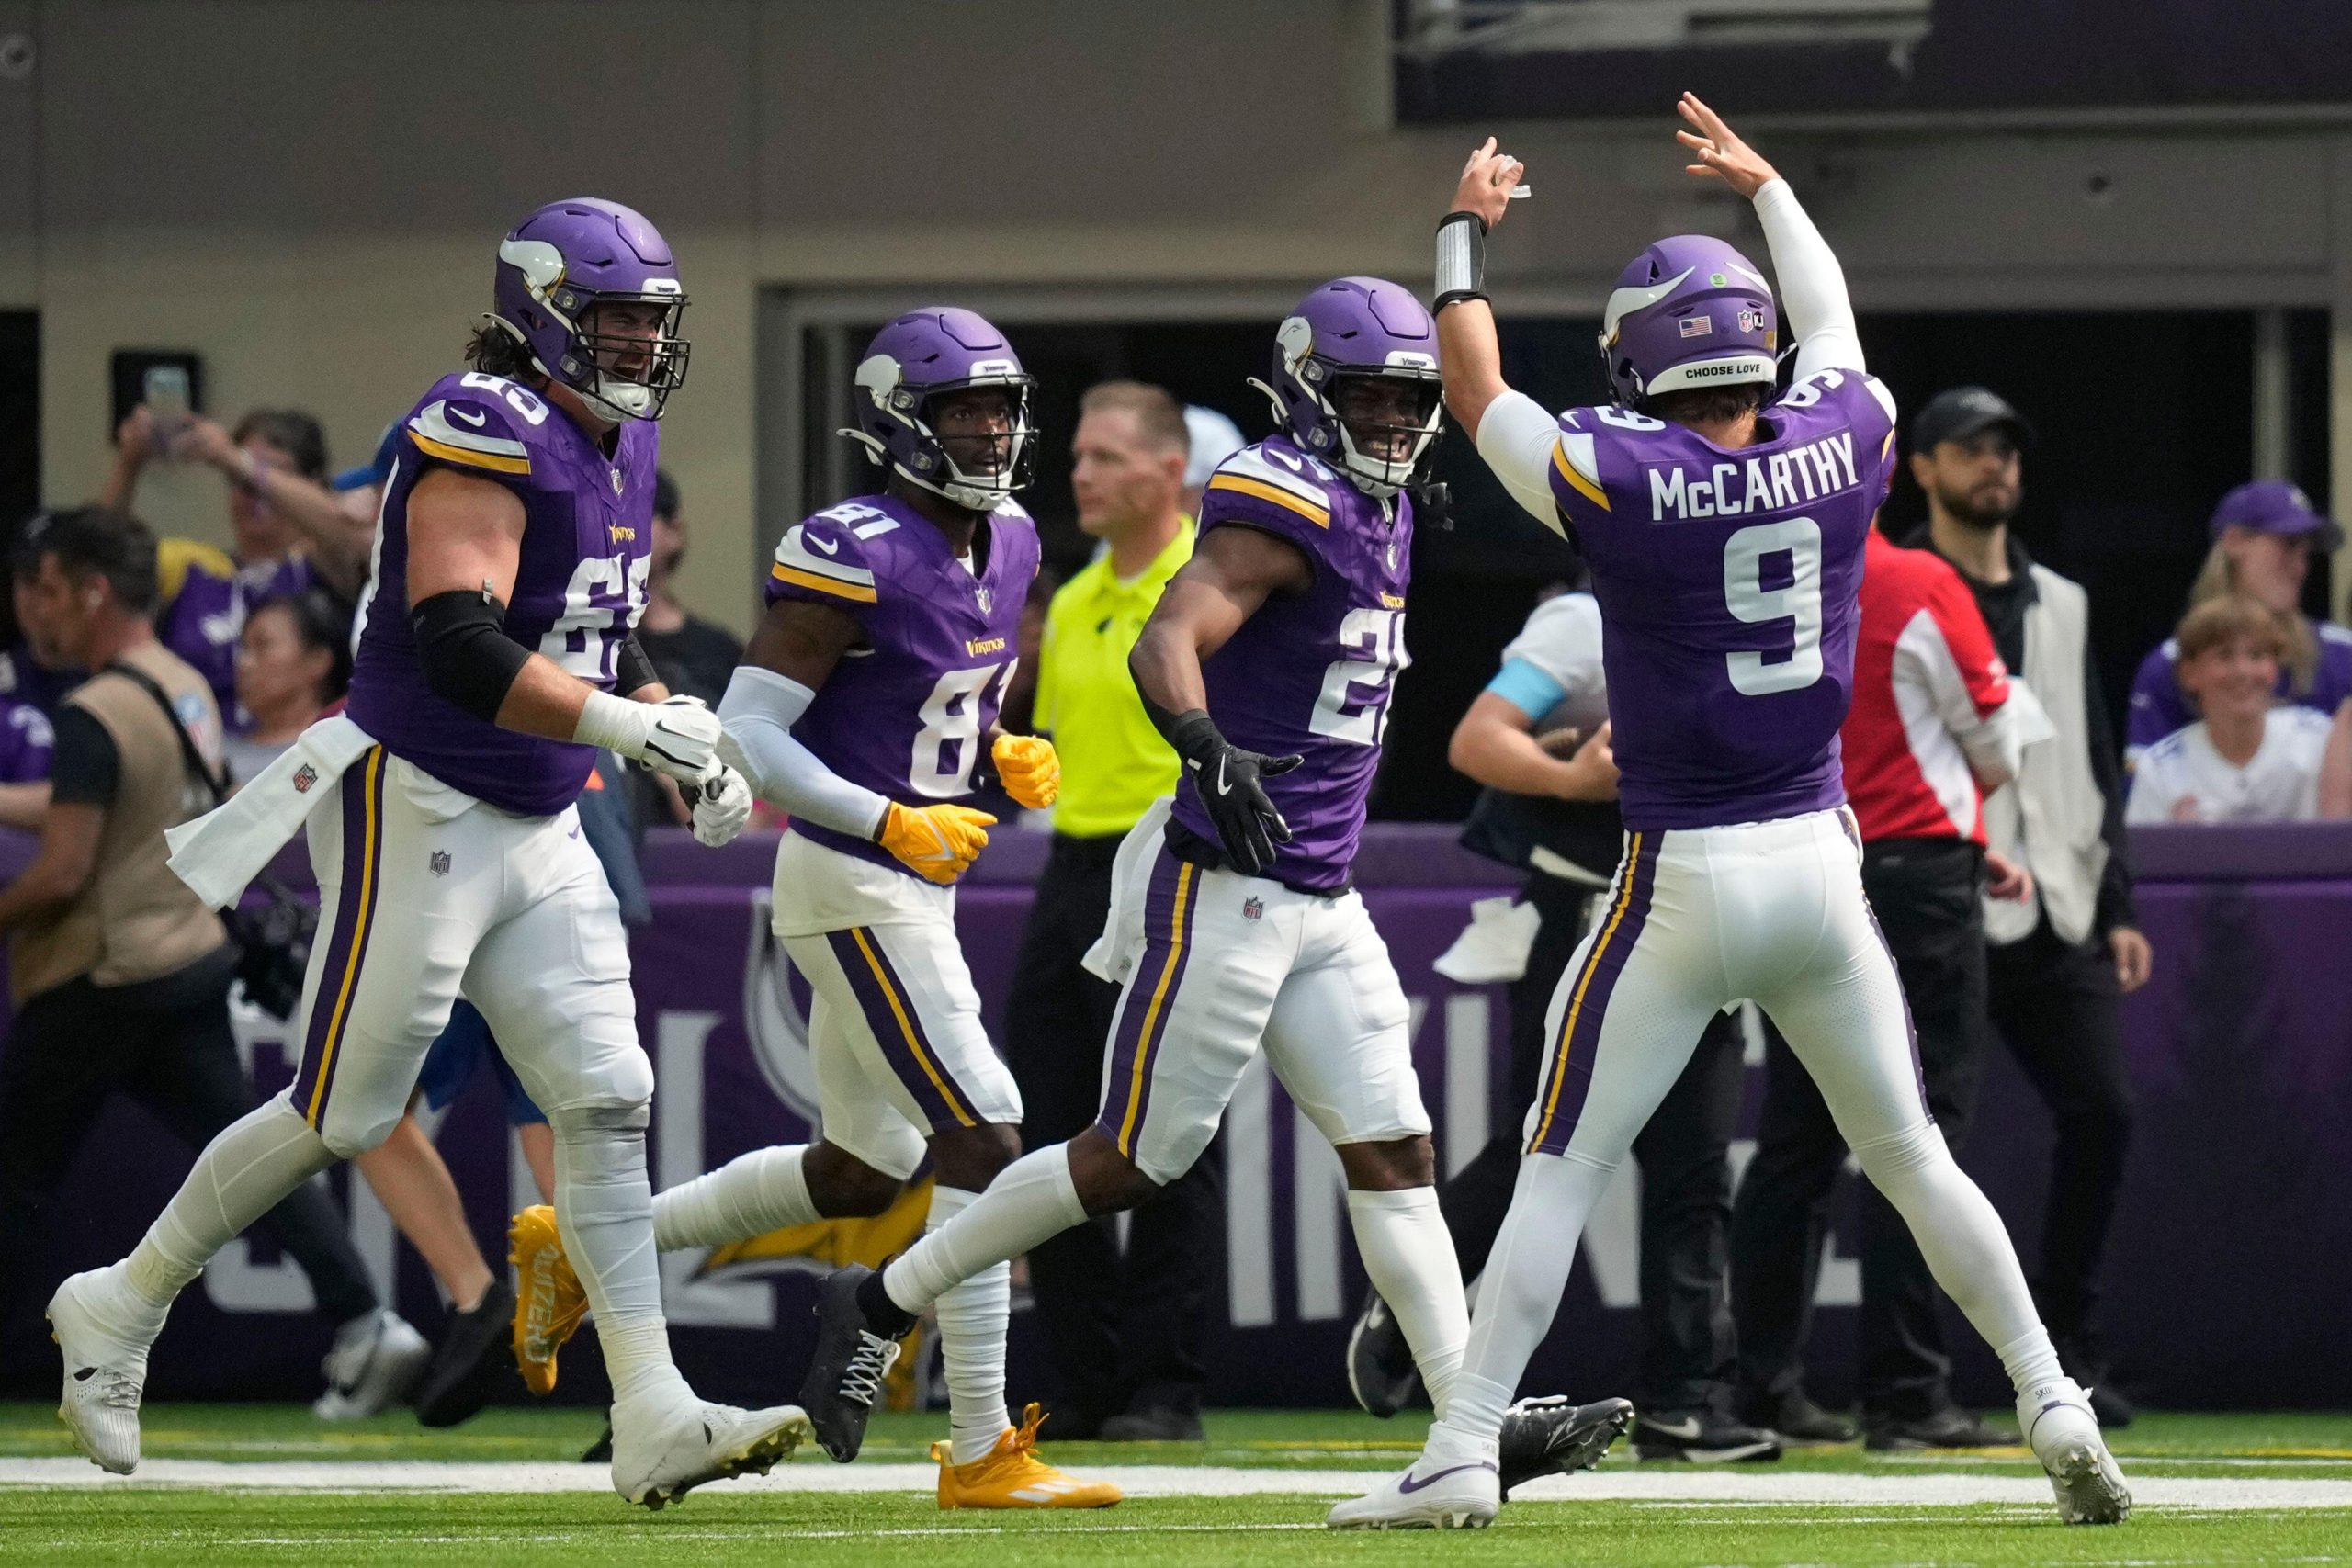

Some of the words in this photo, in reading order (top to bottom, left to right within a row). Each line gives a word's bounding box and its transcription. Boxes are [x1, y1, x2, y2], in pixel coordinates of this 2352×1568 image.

[1685, 366, 1734, 378] CHOOSE
[1736, 363, 1761, 374] LOVE
[1648, 432, 1860, 522] McCARTHY
[815, 503, 901, 541] 81
[1724, 516, 1824, 696] 9
